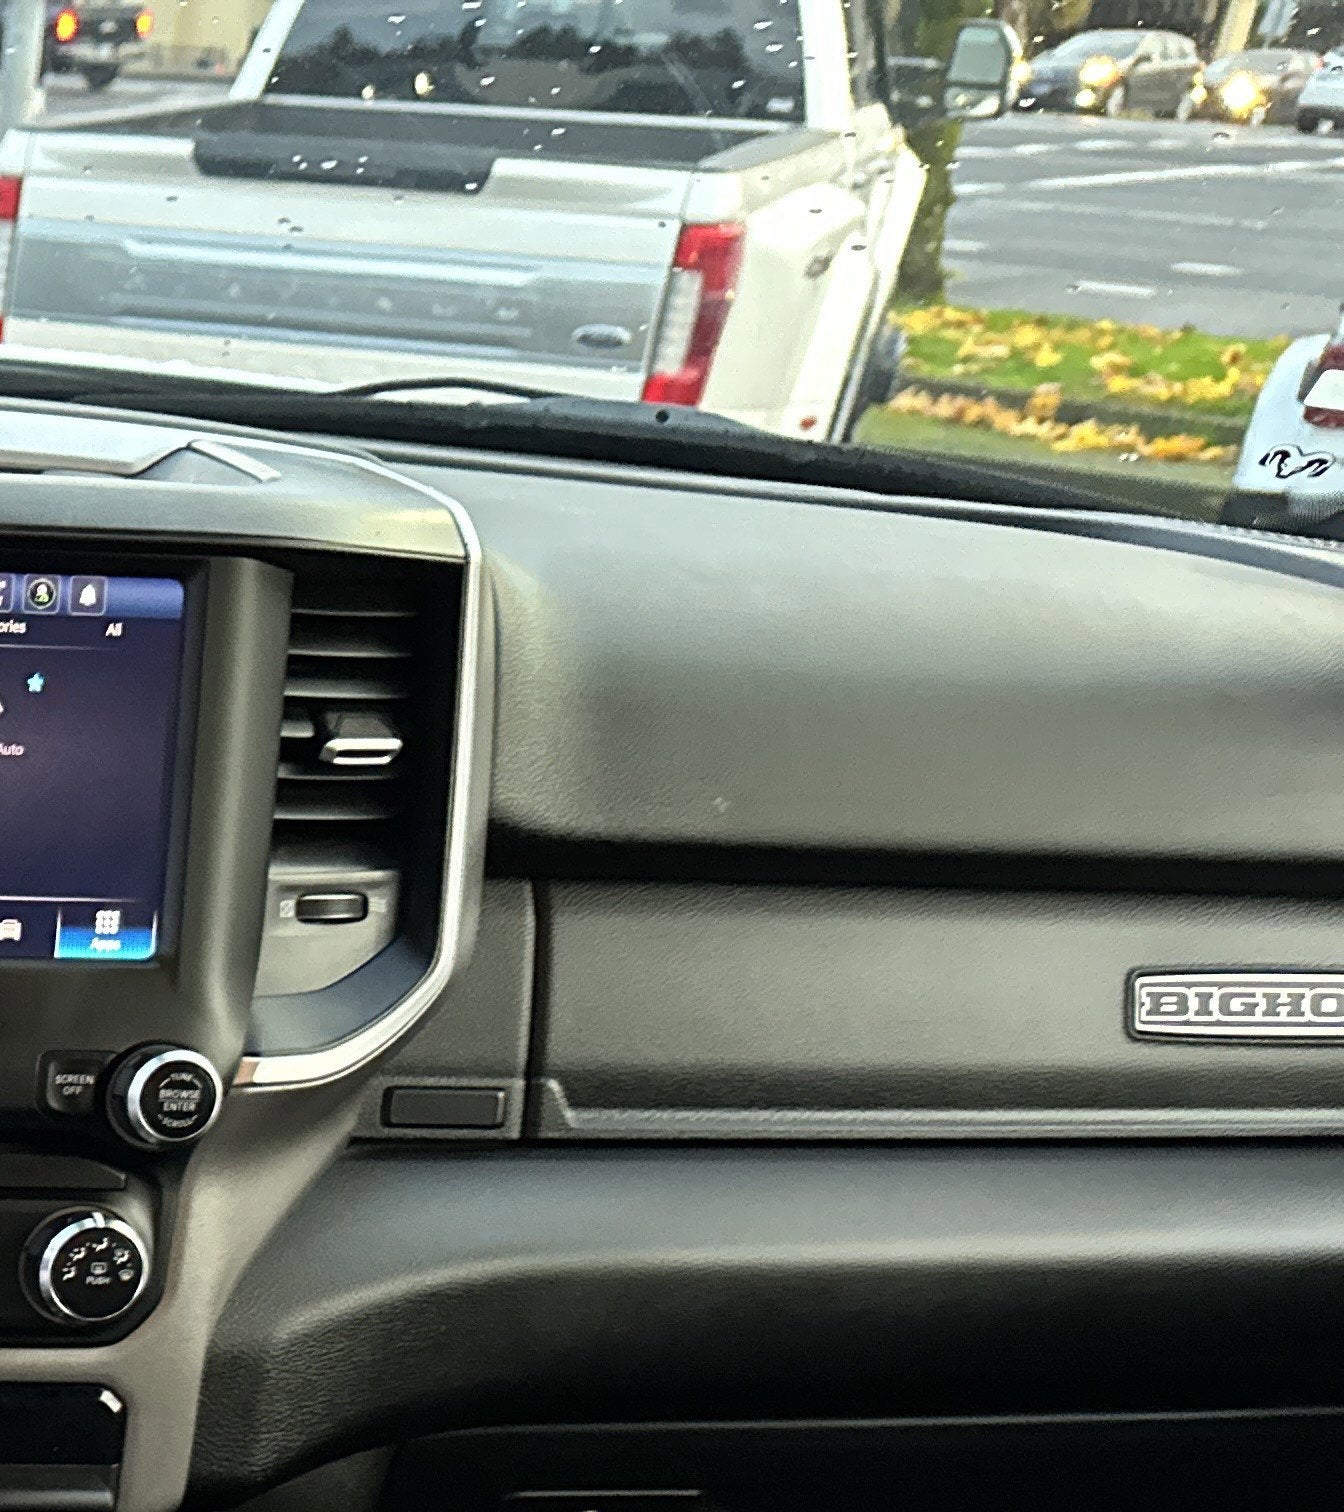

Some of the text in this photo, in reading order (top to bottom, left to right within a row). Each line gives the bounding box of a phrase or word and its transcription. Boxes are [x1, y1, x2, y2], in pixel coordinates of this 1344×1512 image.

[105, 622, 124, 637] All
[55, 1073, 96, 1085] SCREEN
[62, 1085, 84, 1096] OFF
[159, 1088, 202, 1100] BROWSE
[163, 1100, 196, 1112] ENTER
[85, 1275, 111, 1285] PUSH
